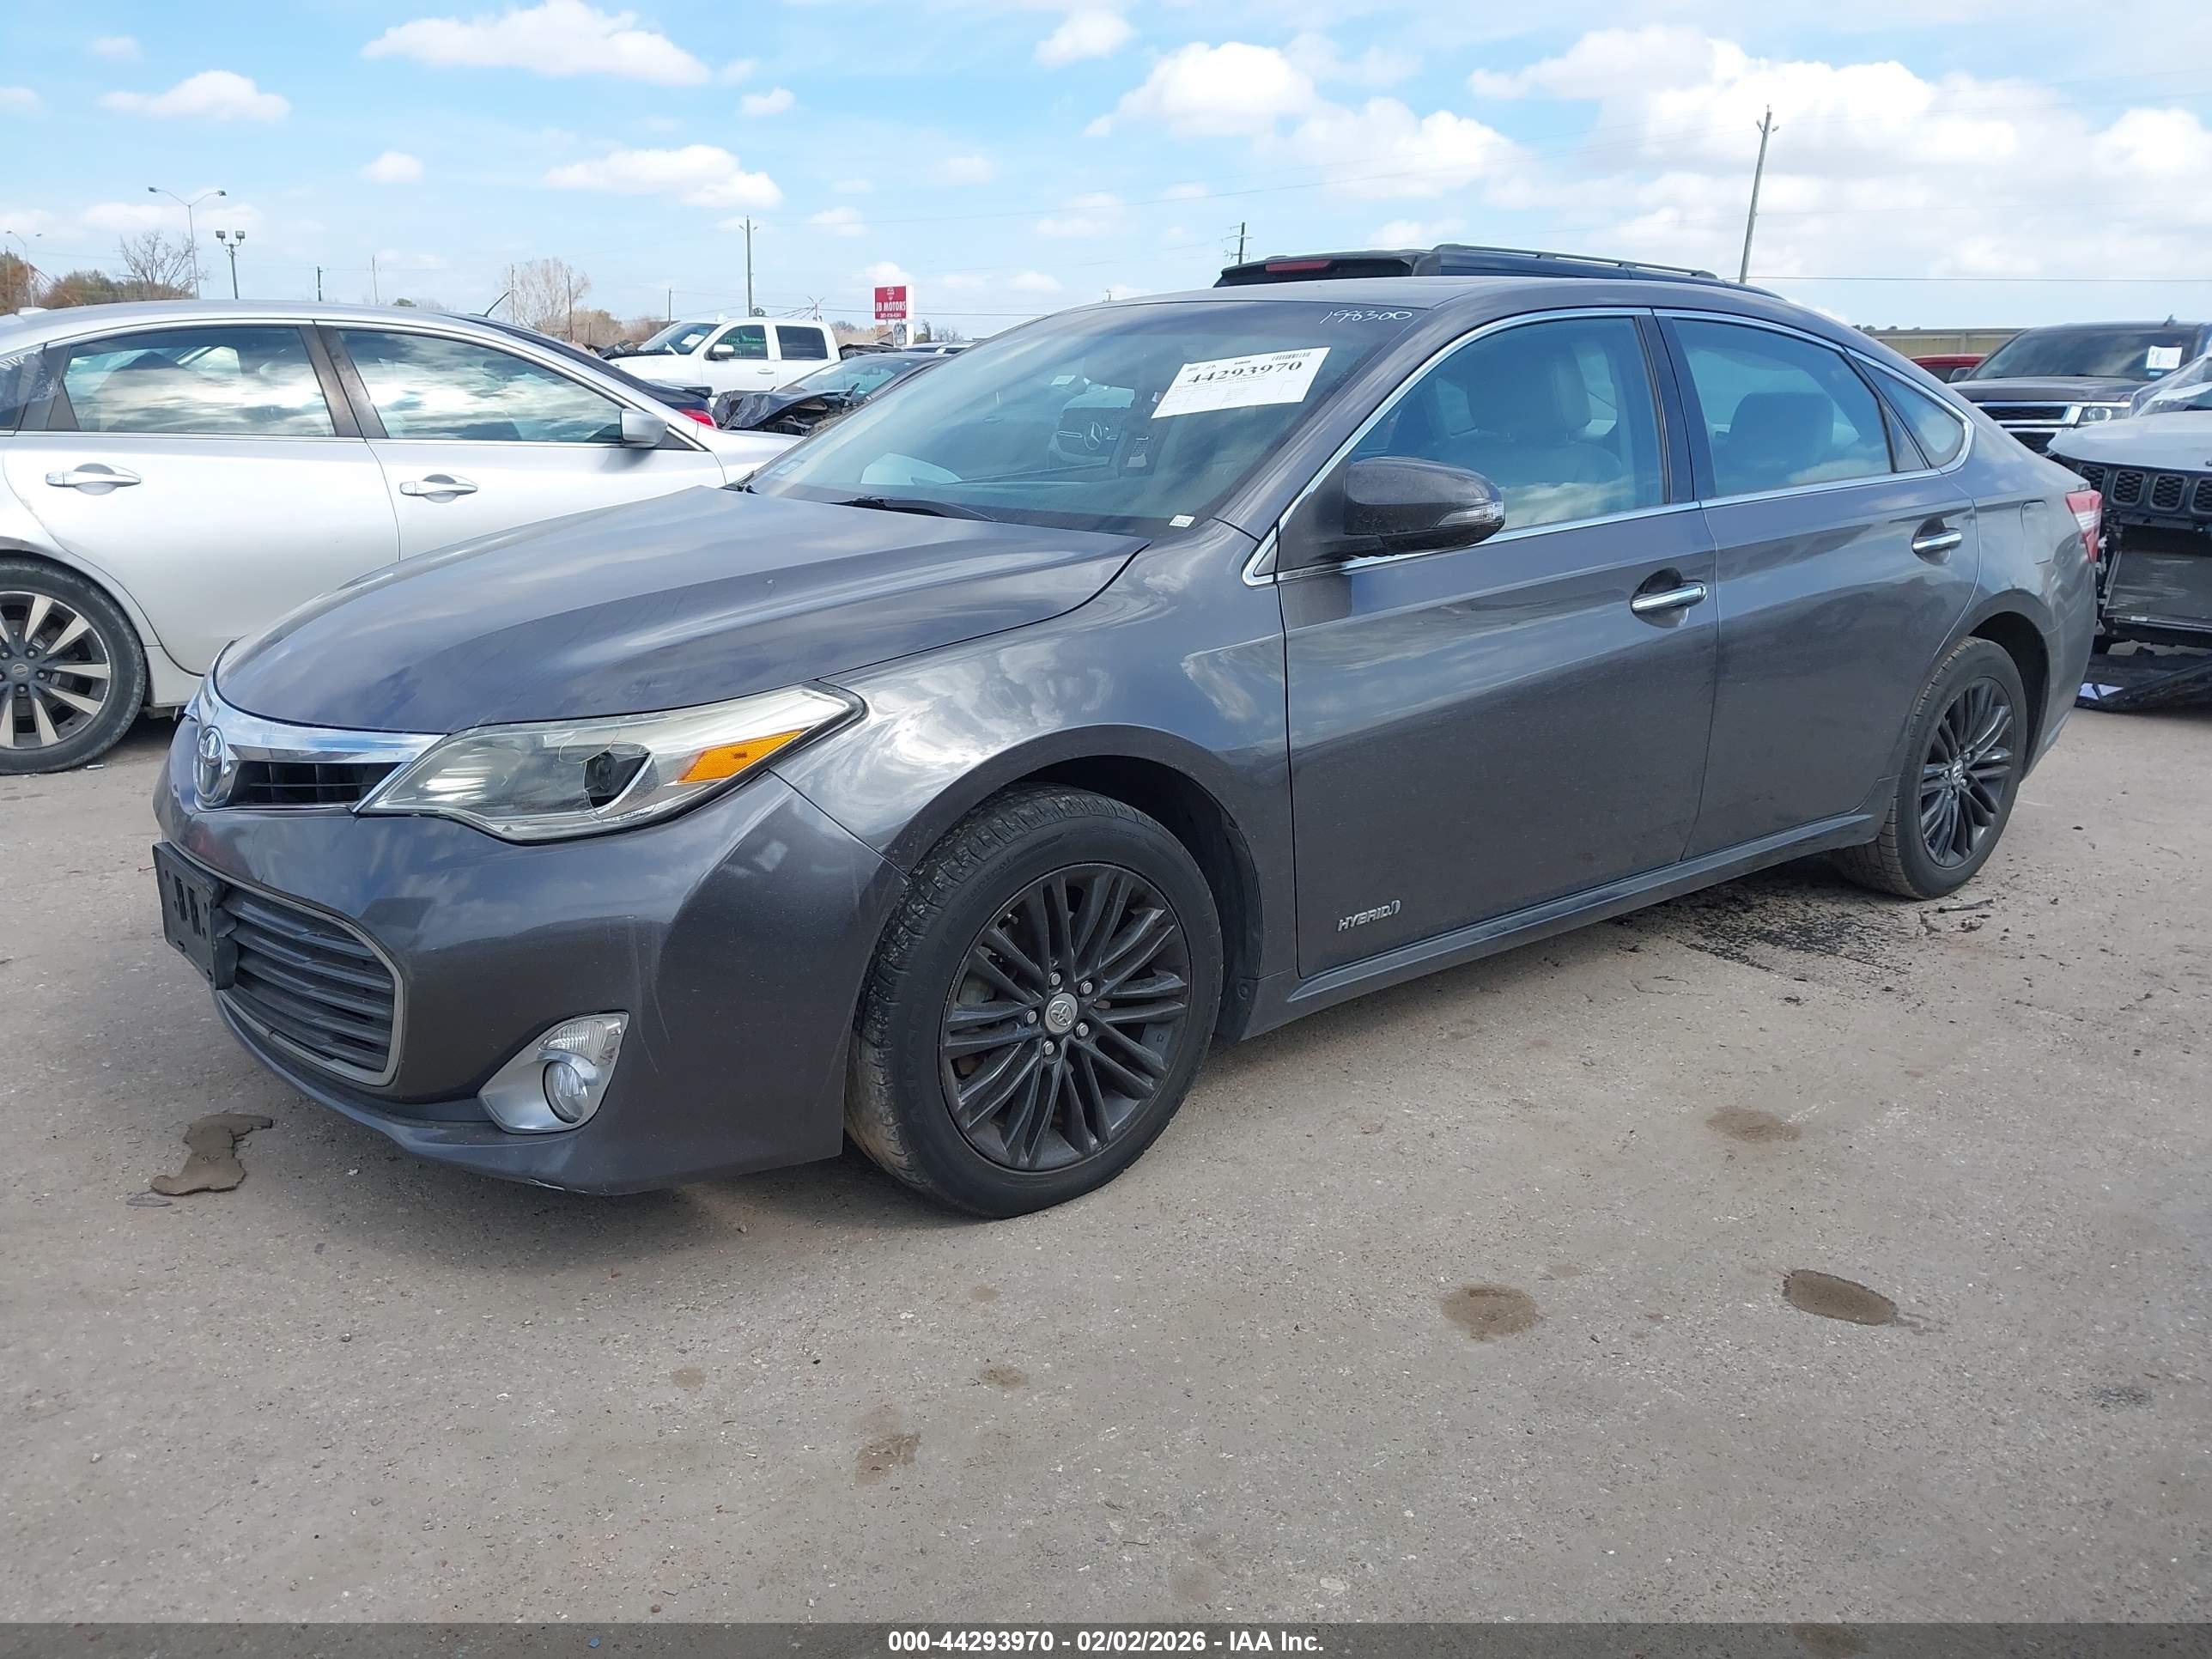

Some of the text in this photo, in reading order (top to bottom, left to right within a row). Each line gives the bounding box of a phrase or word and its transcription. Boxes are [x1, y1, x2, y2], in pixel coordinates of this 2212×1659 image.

[884, 301, 906, 312] MOTORS
[1188, 360, 1303, 383] 44293970
[1337, 904, 1390, 932] HYBRID
